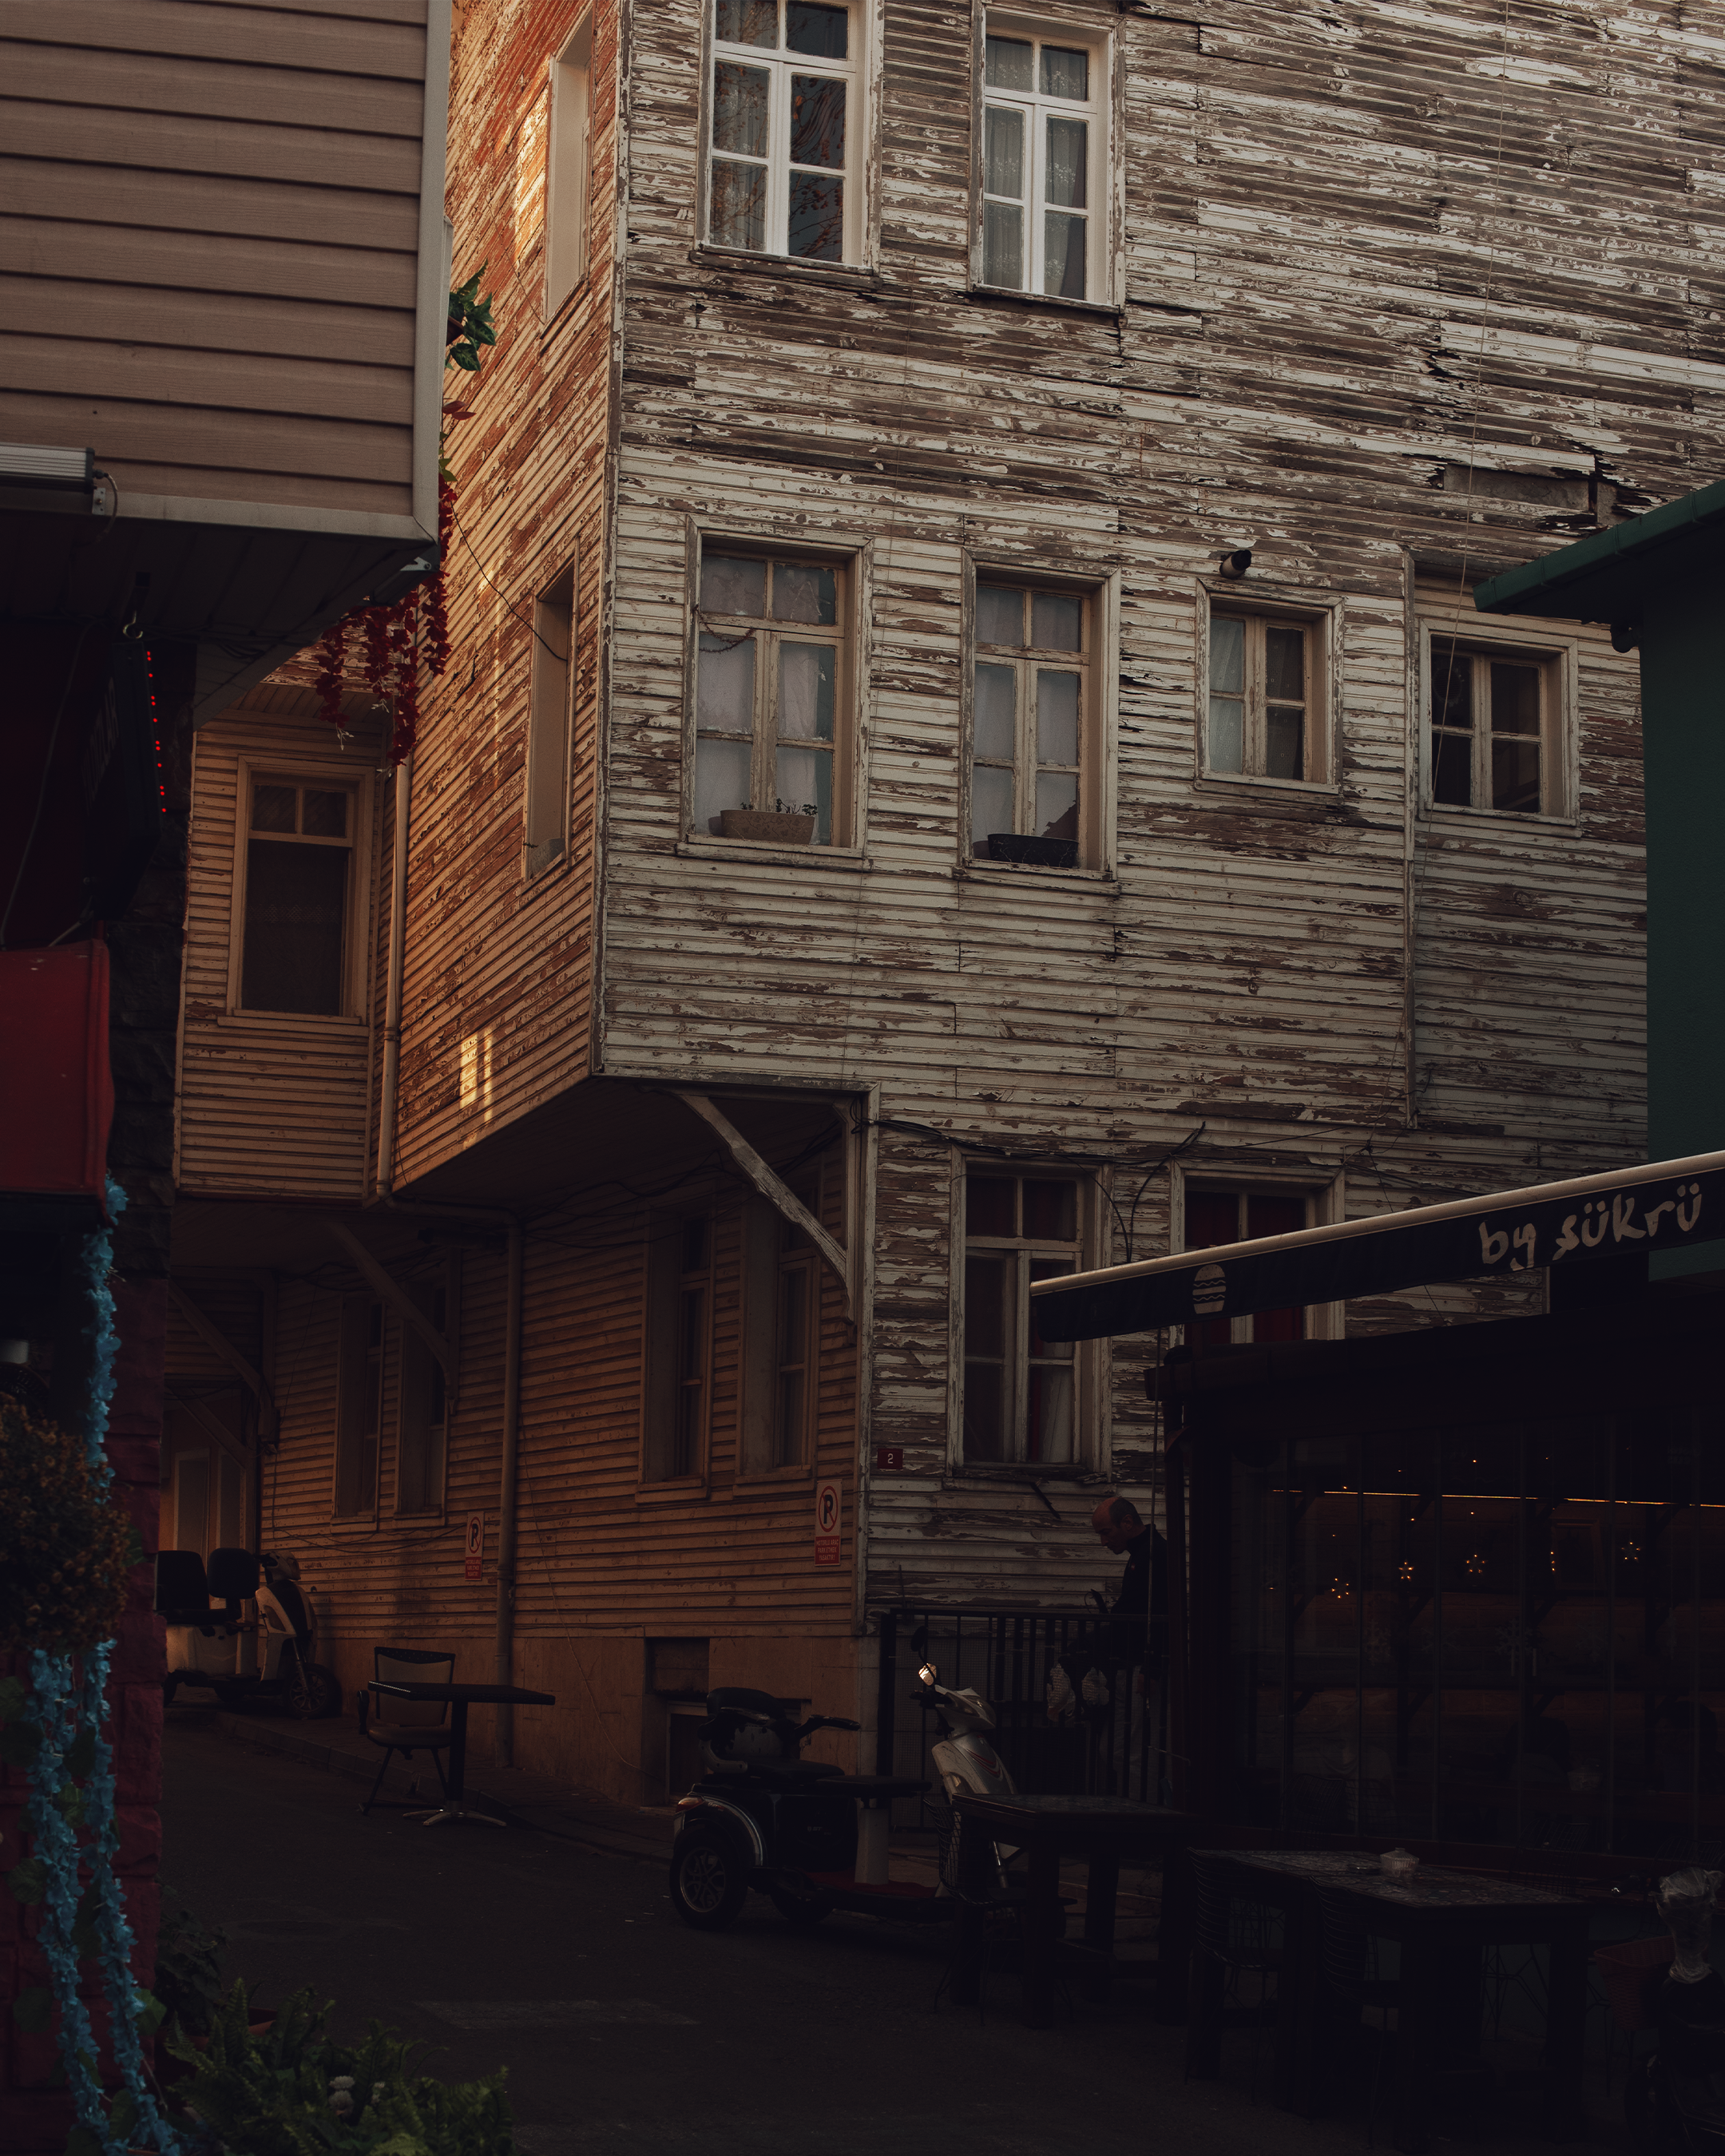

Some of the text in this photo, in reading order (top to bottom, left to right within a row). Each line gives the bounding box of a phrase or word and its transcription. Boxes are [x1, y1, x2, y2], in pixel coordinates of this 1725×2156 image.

[1478, 1182, 1702, 1271] by şükrü
[887, 1453, 894, 1464] 2
[823, 1495, 833, 1524] P
[471, 1524, 479, 1547] P
